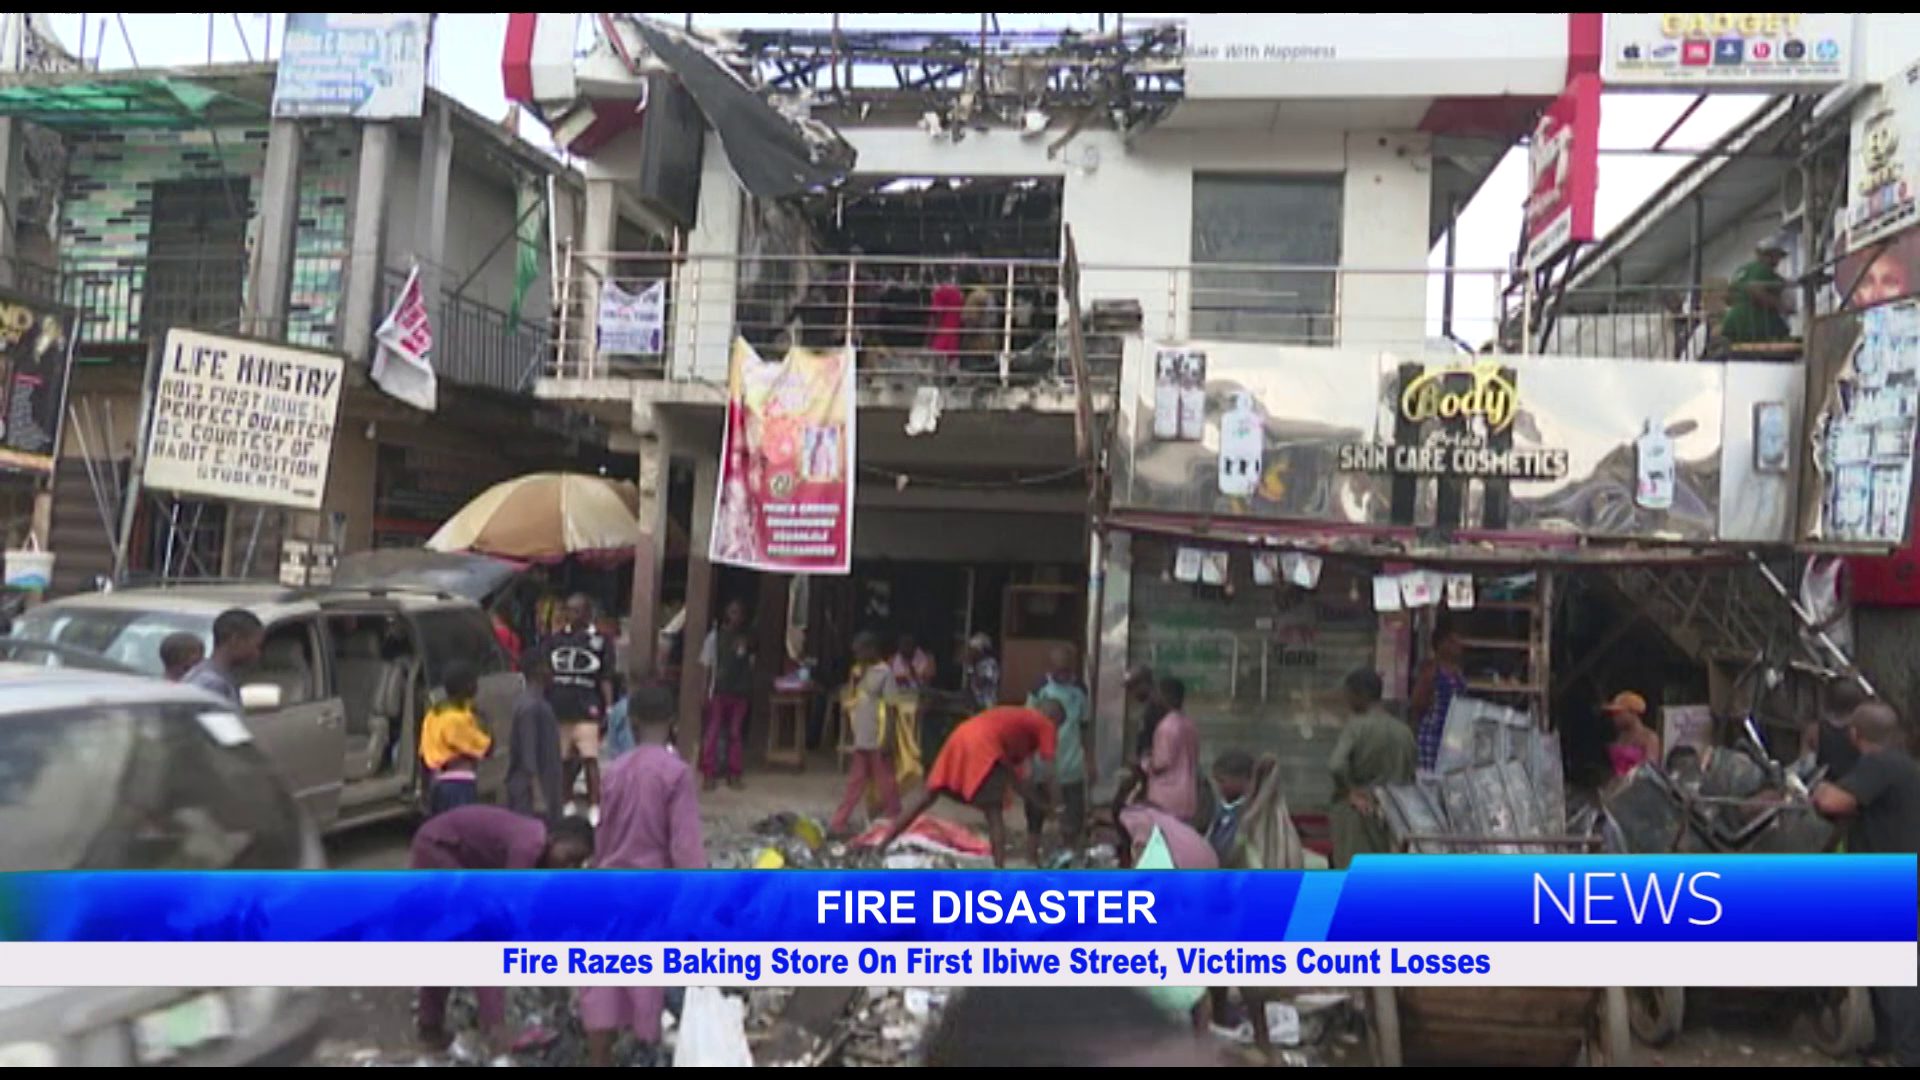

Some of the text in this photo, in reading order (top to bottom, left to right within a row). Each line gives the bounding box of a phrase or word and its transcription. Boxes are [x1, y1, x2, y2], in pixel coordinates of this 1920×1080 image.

[1225, 43, 1259, 58] With
[210, 385, 262, 409] FIRST
[1404, 371, 1513, 431] Body
[159, 396, 332, 443] PERFECT QUARTER
[191, 424, 285, 453] COURTESY
[290, 438, 316, 459] OF
[1339, 445, 1568, 476] SKIN CARE COSMETICS
